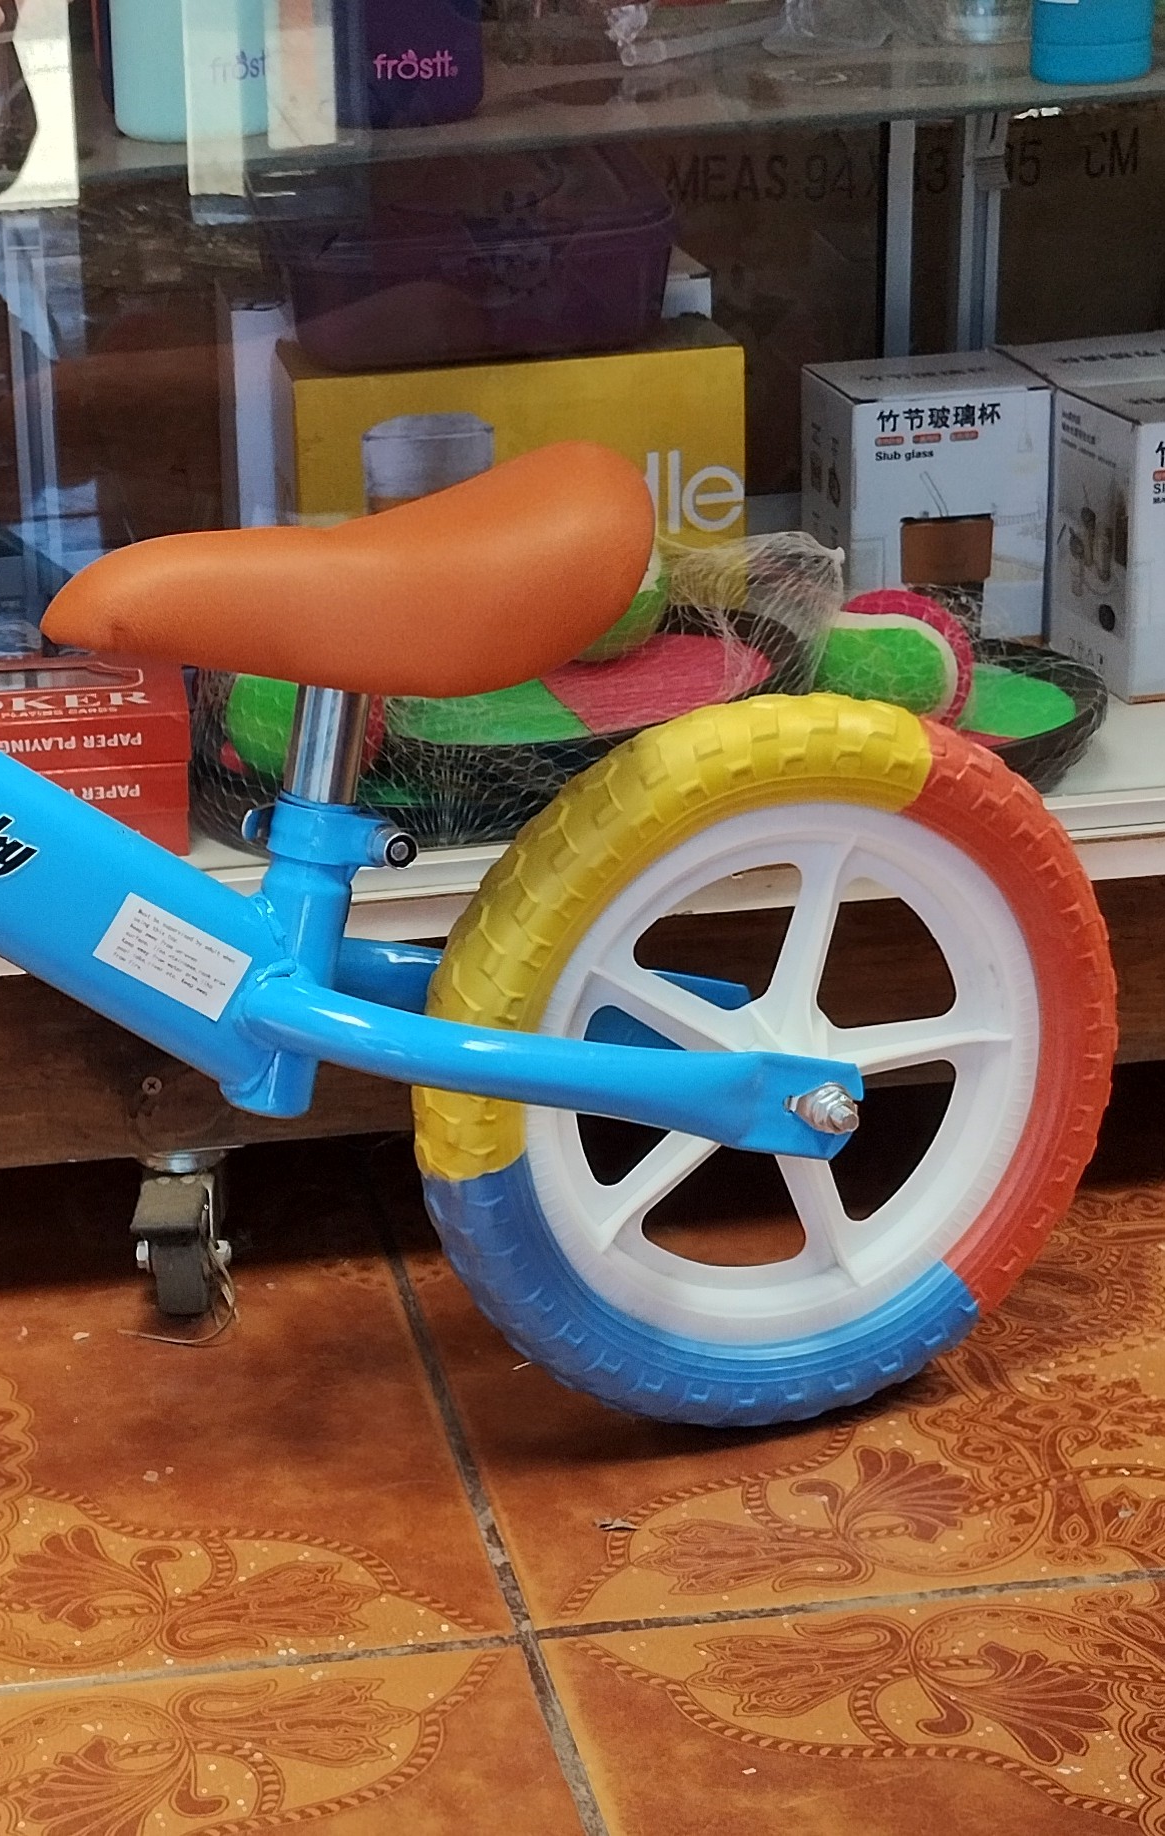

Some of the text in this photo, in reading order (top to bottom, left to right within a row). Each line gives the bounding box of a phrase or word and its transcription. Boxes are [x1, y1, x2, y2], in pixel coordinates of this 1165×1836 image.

[876, 402, 1001, 432] 竹节玻璃杯
[904, 449, 934, 461] glass
[83, 732, 142, 748] PAPER
[82, 784, 141, 801] PAPER
